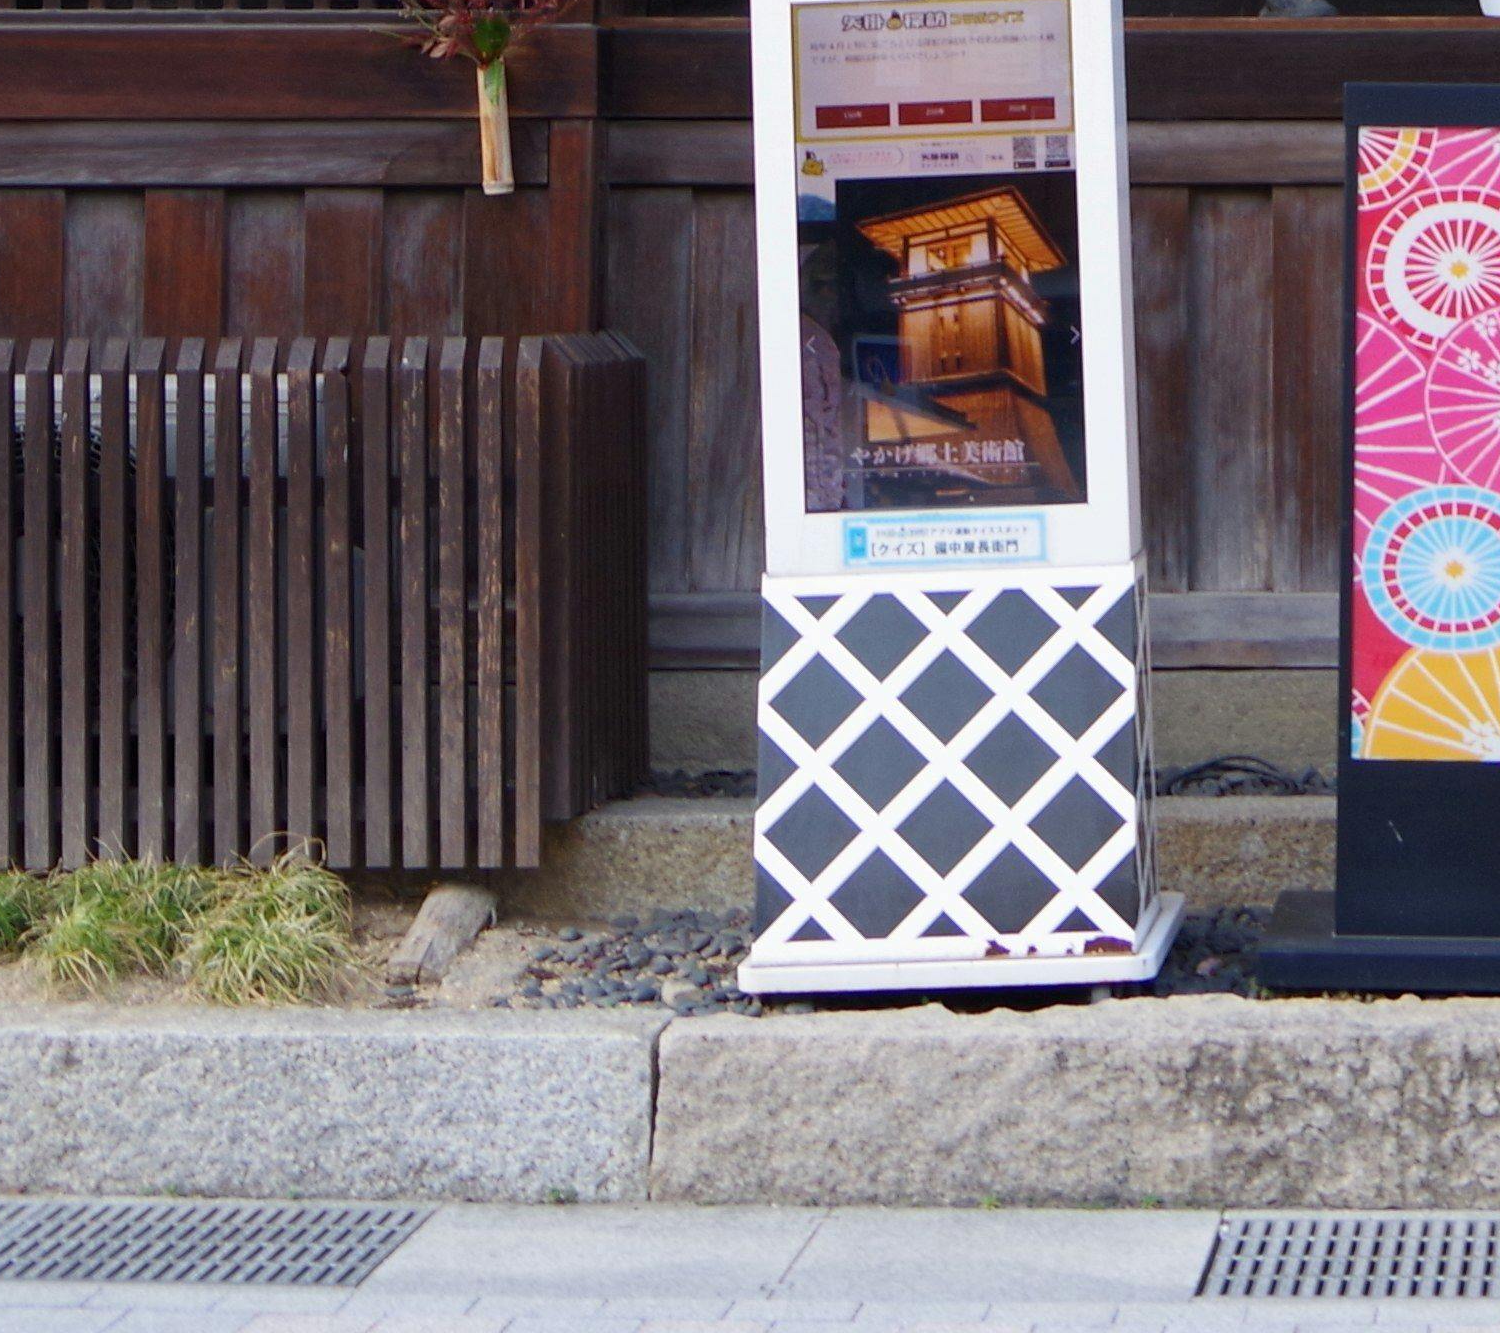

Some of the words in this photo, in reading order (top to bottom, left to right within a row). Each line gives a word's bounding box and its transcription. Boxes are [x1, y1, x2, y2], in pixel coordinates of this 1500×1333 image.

[851, 439, 1026, 466] やかげ郷土美術館
